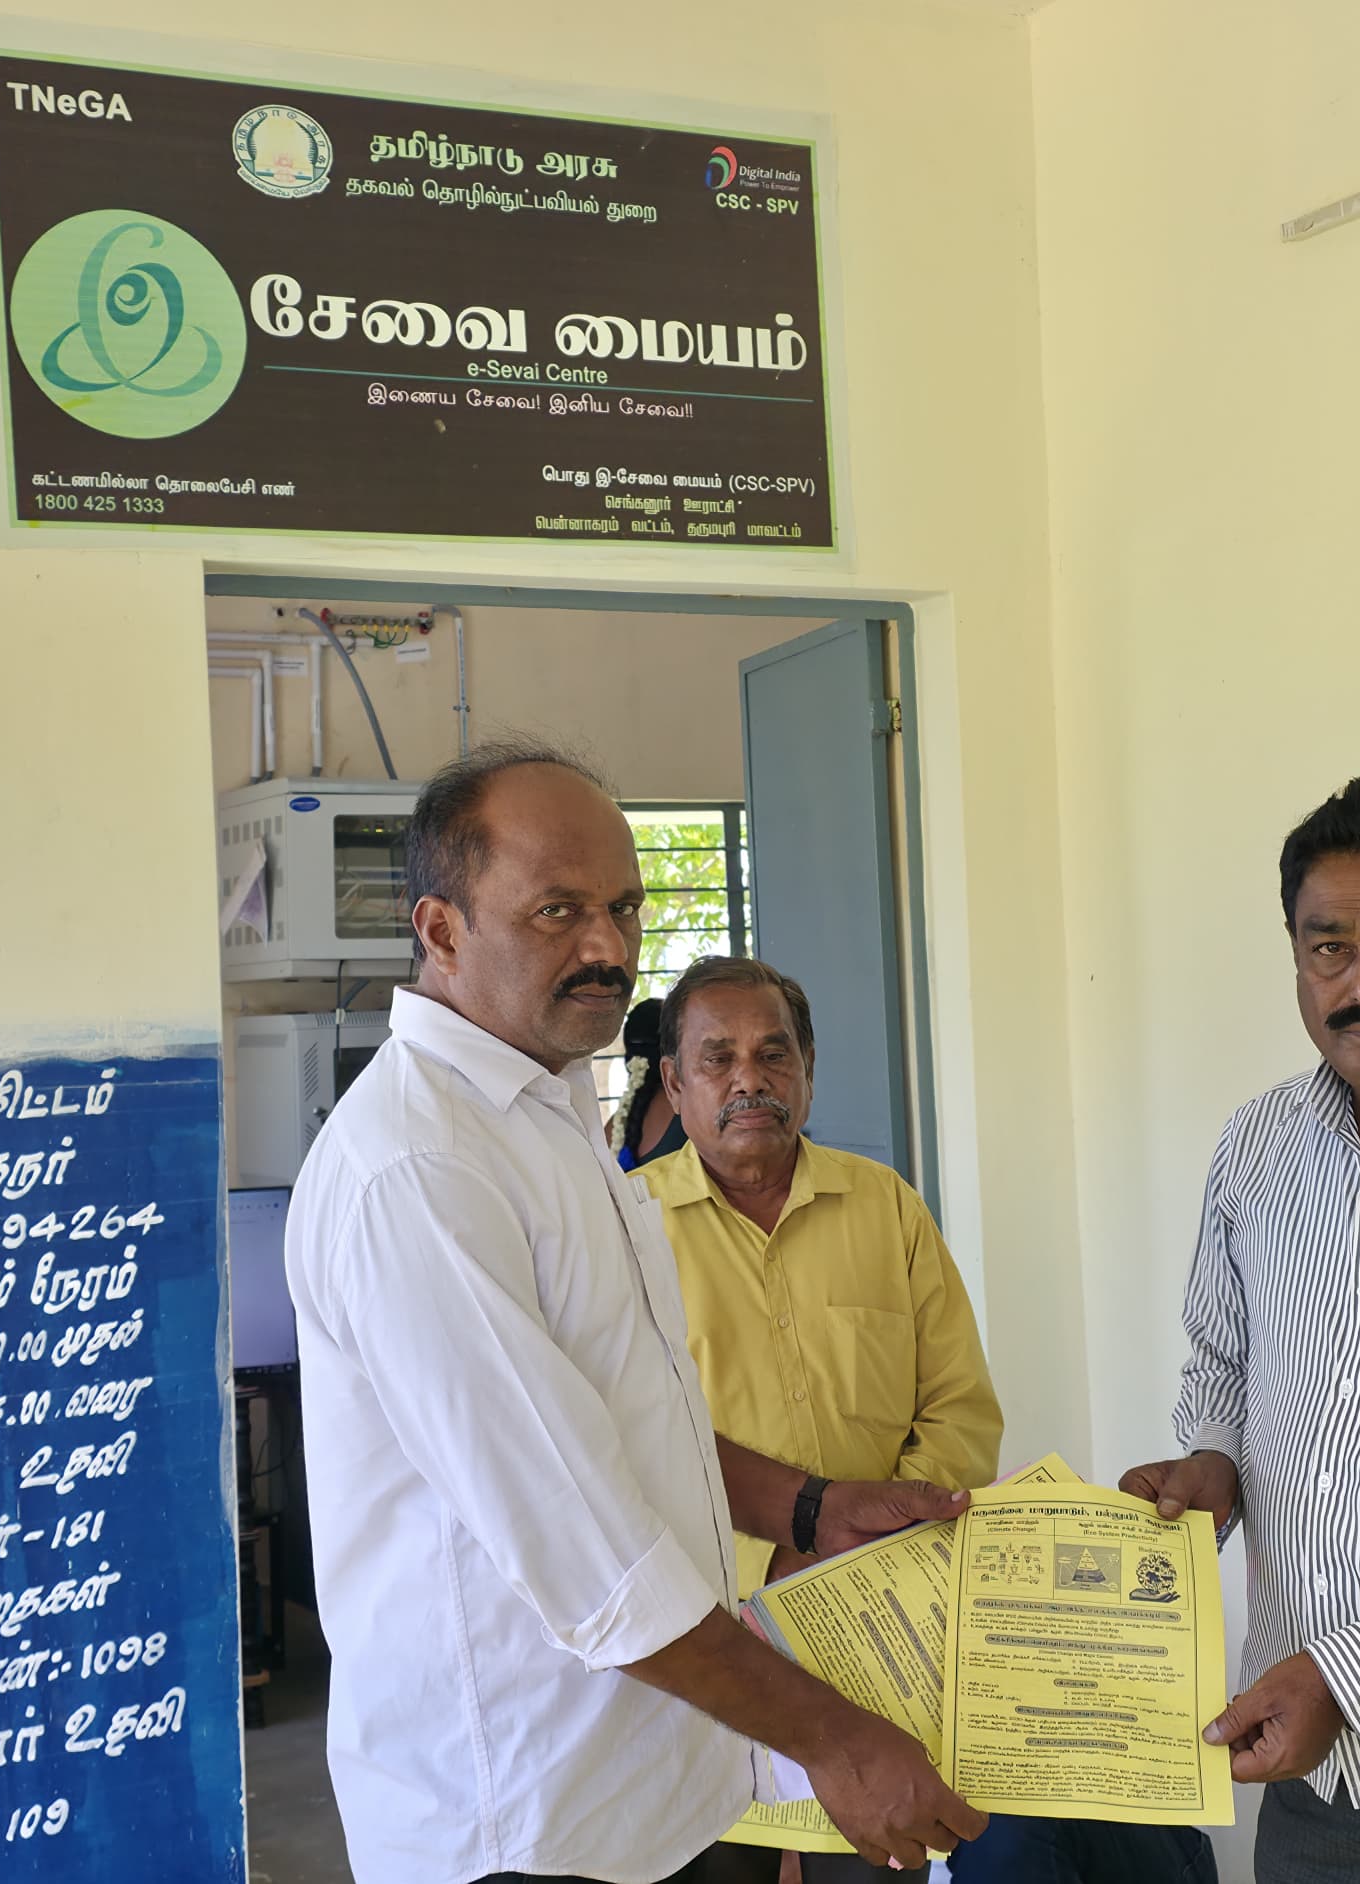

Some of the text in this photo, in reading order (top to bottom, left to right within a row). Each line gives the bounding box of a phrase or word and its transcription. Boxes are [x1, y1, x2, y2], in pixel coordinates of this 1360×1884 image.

[7, 81, 132, 122] TNeGA
[370, 130, 619, 181] தமிழ்நாடு அரசு
[739, 165, 801, 182] Digital India
[345, 176, 415, 197] தகவல்
[422, 179, 600, 215] தொழில்நுட்பவியல்
[606, 201, 658, 223] துறை
[716, 192, 751, 210] CSC
[766, 197, 799, 215] SPV
[739, 179, 800, 192] Power To Empower
[249, 273, 808, 373] சேவை மையம்
[466, 359, 609, 385] e-Sevai Centre
[366, 383, 457, 407] இணைய
[464, 386, 541, 412] சேவை!
[548, 393, 611, 416] இனிய
[31, 470, 297, 497] கட்டணமில்லா தொலைபேசி எண்
[542, 464, 817, 497] பொது இ-சேவை மையம் (CSC-SPV)
[35, 494, 165, 514] 1800 425 1333
[535, 514, 620, 533] பென்னாகரம்
[687, 521, 737, 538] தருமபுரி
[747, 521, 803, 538] மாவட்டம்
[29, 1243, 139, 1315] நேரம்
[50, 1308, 145, 1368] முதல்
[64, 1375, 154, 1422] வரை
[18, 1430, 138, 1496] உதவி
[63, 1686, 188, 1758] உதவி
